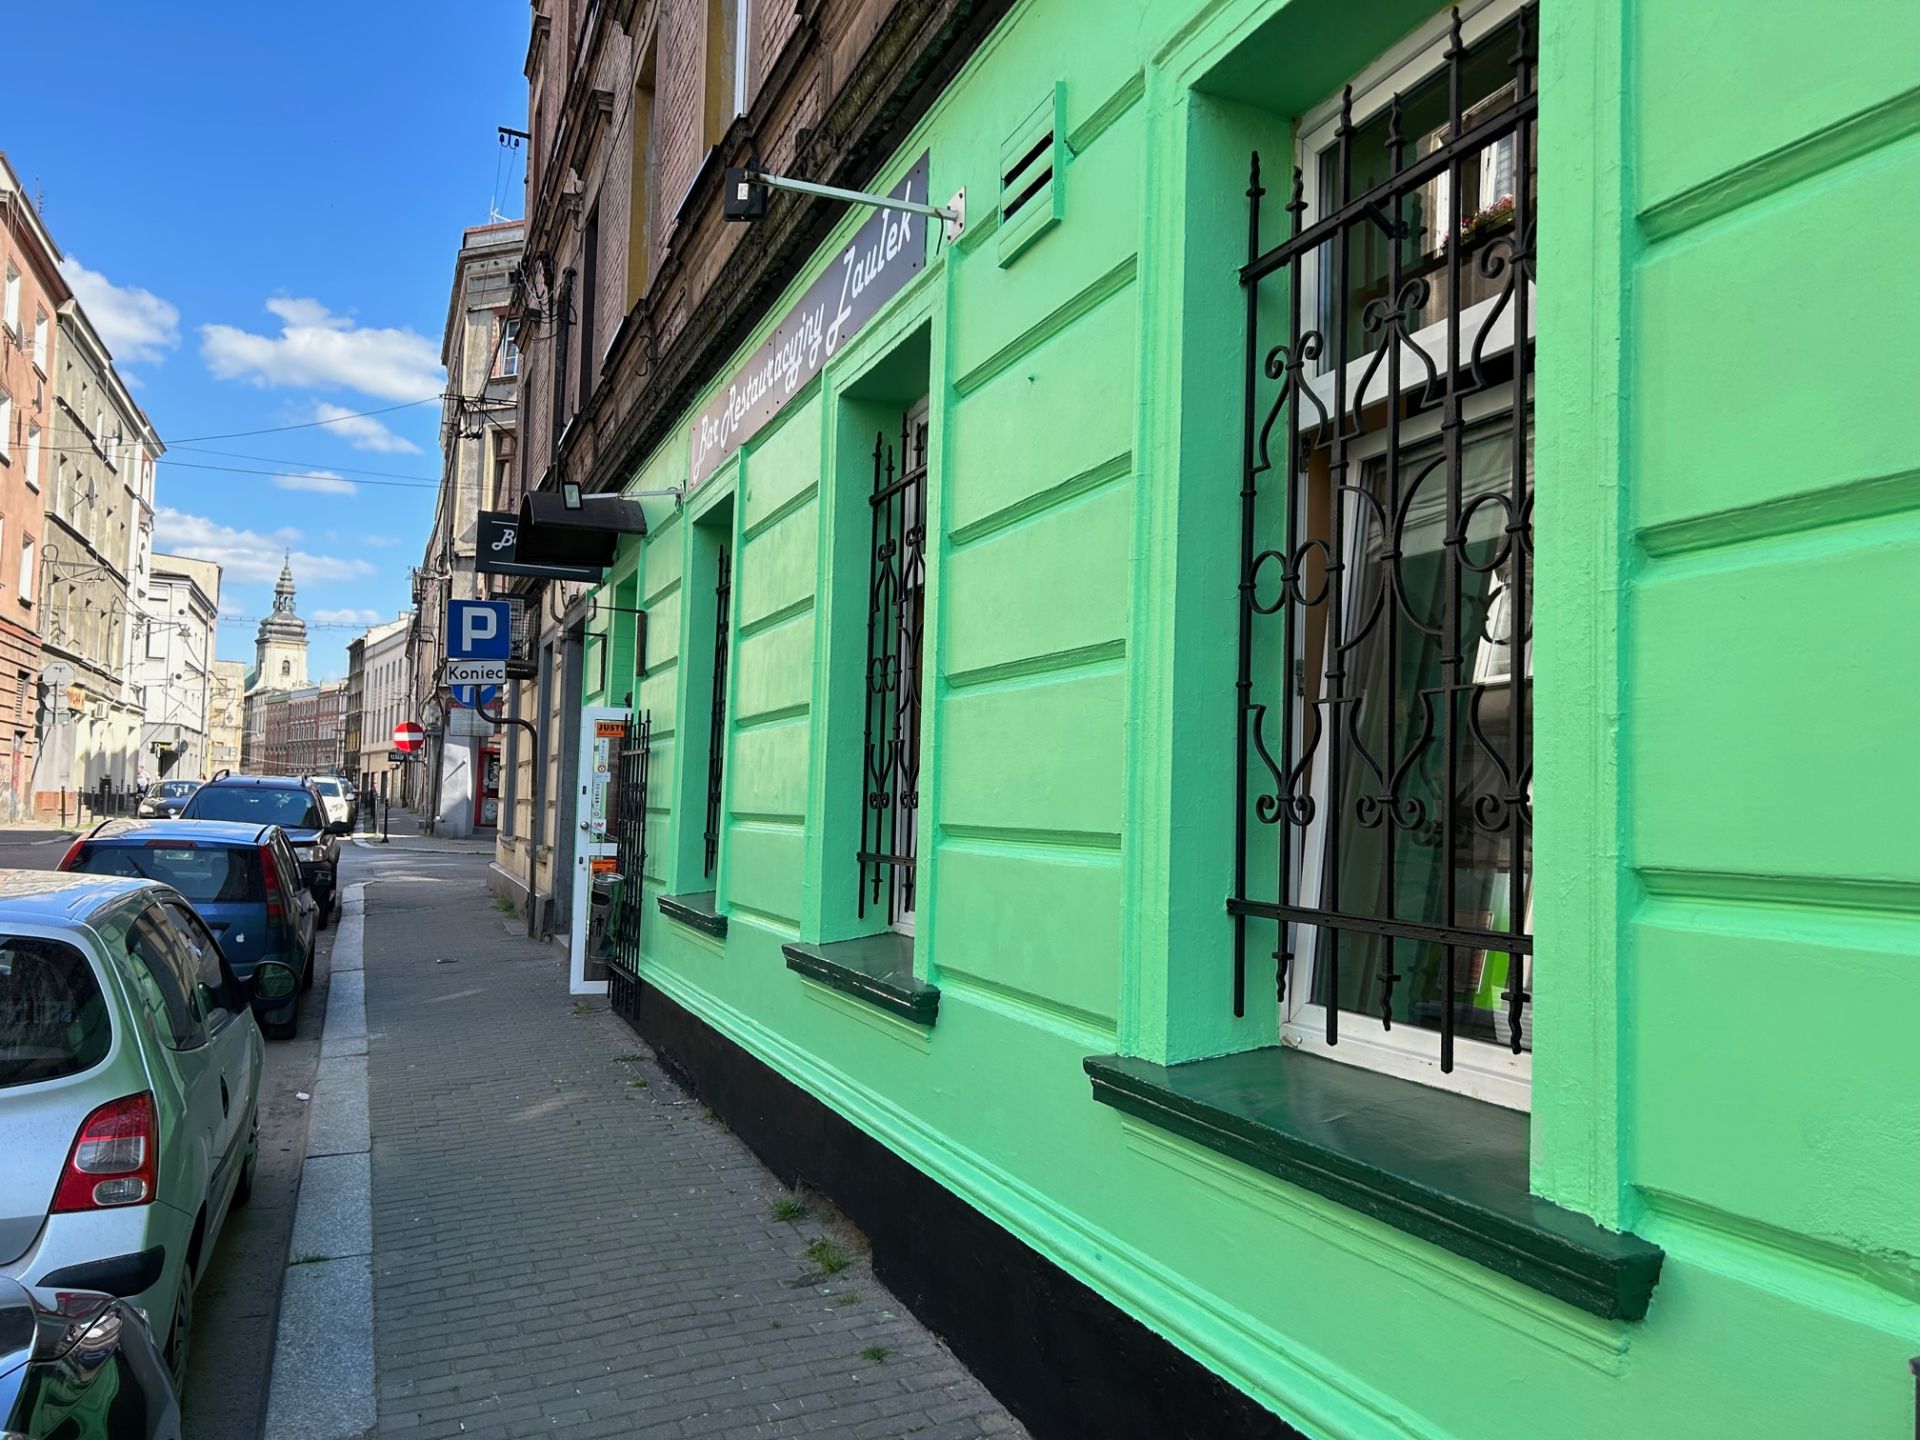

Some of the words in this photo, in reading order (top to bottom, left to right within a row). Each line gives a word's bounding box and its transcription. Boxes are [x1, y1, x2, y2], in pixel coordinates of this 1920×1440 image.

[692, 415, 719, 483] Bar
[720, 303, 824, 448] Restauracyjny
[491, 529, 517, 550] B
[462, 607, 497, 651] P
[448, 665, 504, 680] Koniec
